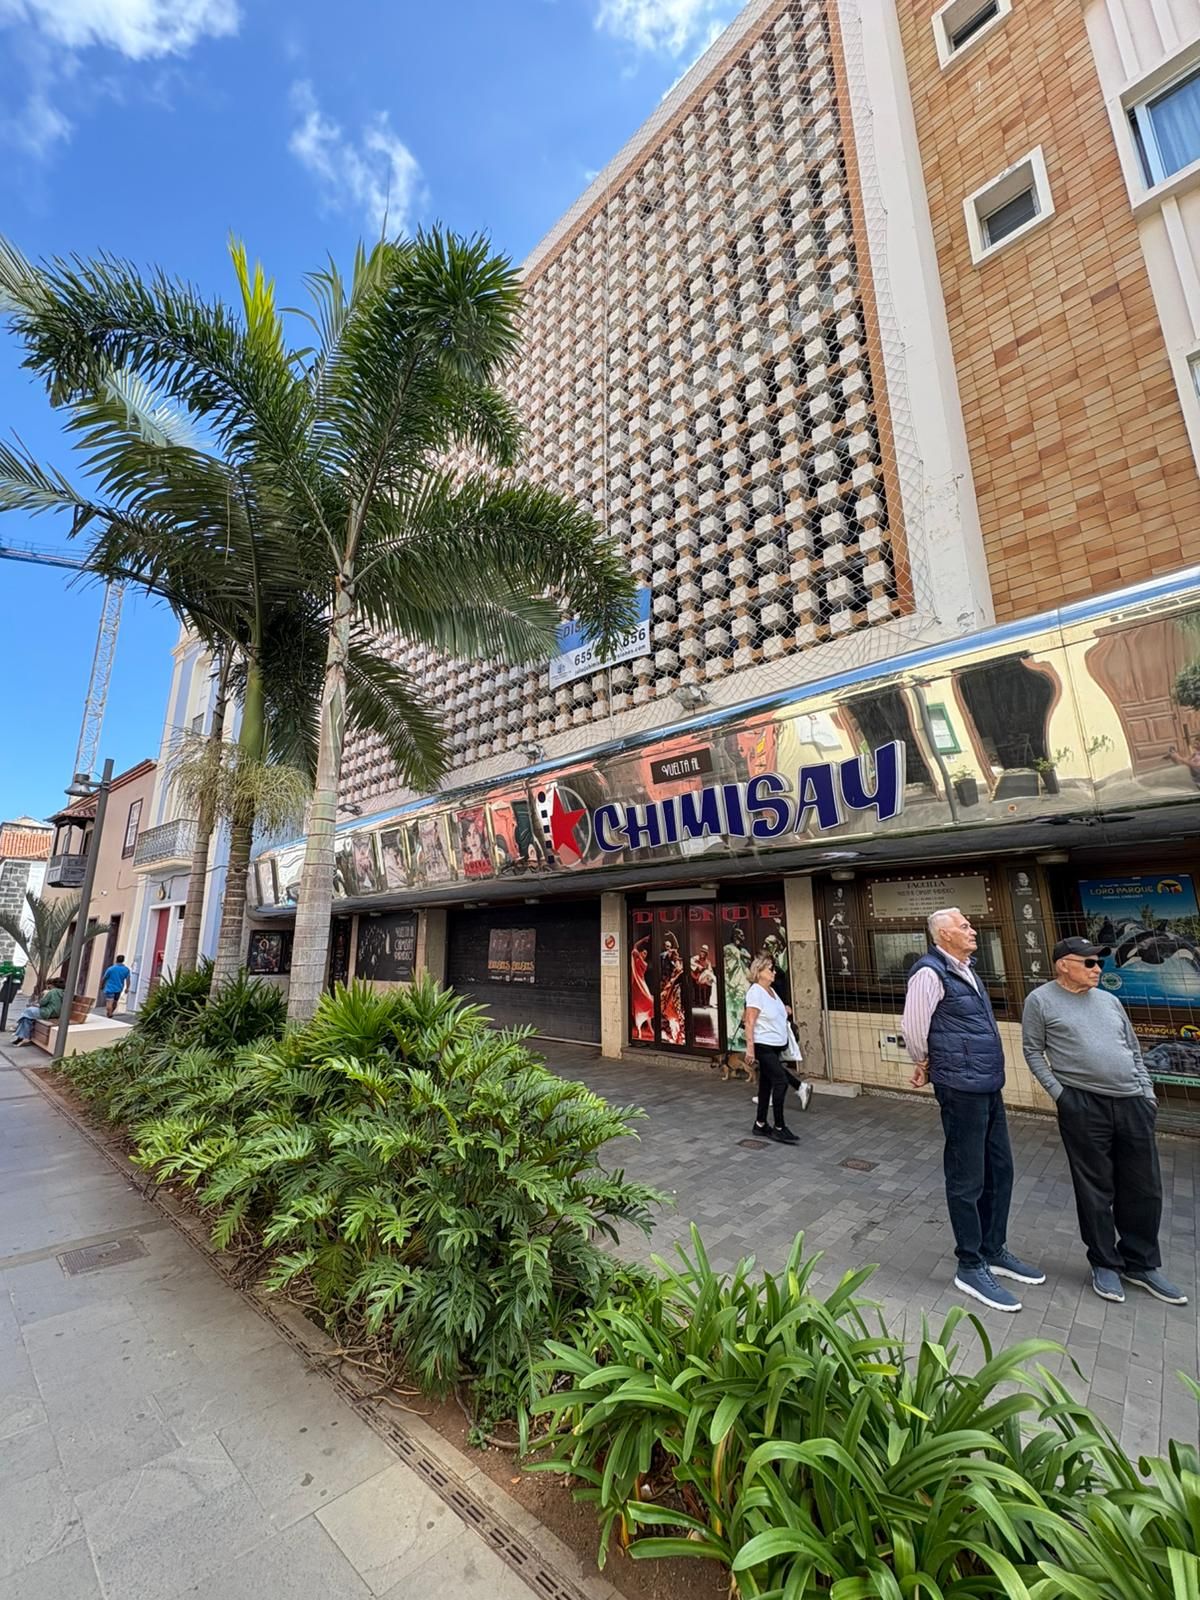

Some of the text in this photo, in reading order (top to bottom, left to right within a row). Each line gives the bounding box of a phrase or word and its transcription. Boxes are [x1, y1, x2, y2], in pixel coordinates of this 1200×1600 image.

[574, 648, 592, 666] 655
[623, 628, 646, 647] 856
[661, 757, 701, 777] VUELTA AL
[593, 740, 905, 853] CHIMISAY
[1089, 887, 1114, 896] LORO
[1115, 885, 1154, 895] PARQUE
[1144, 1027, 1177, 1036] PARQUE
